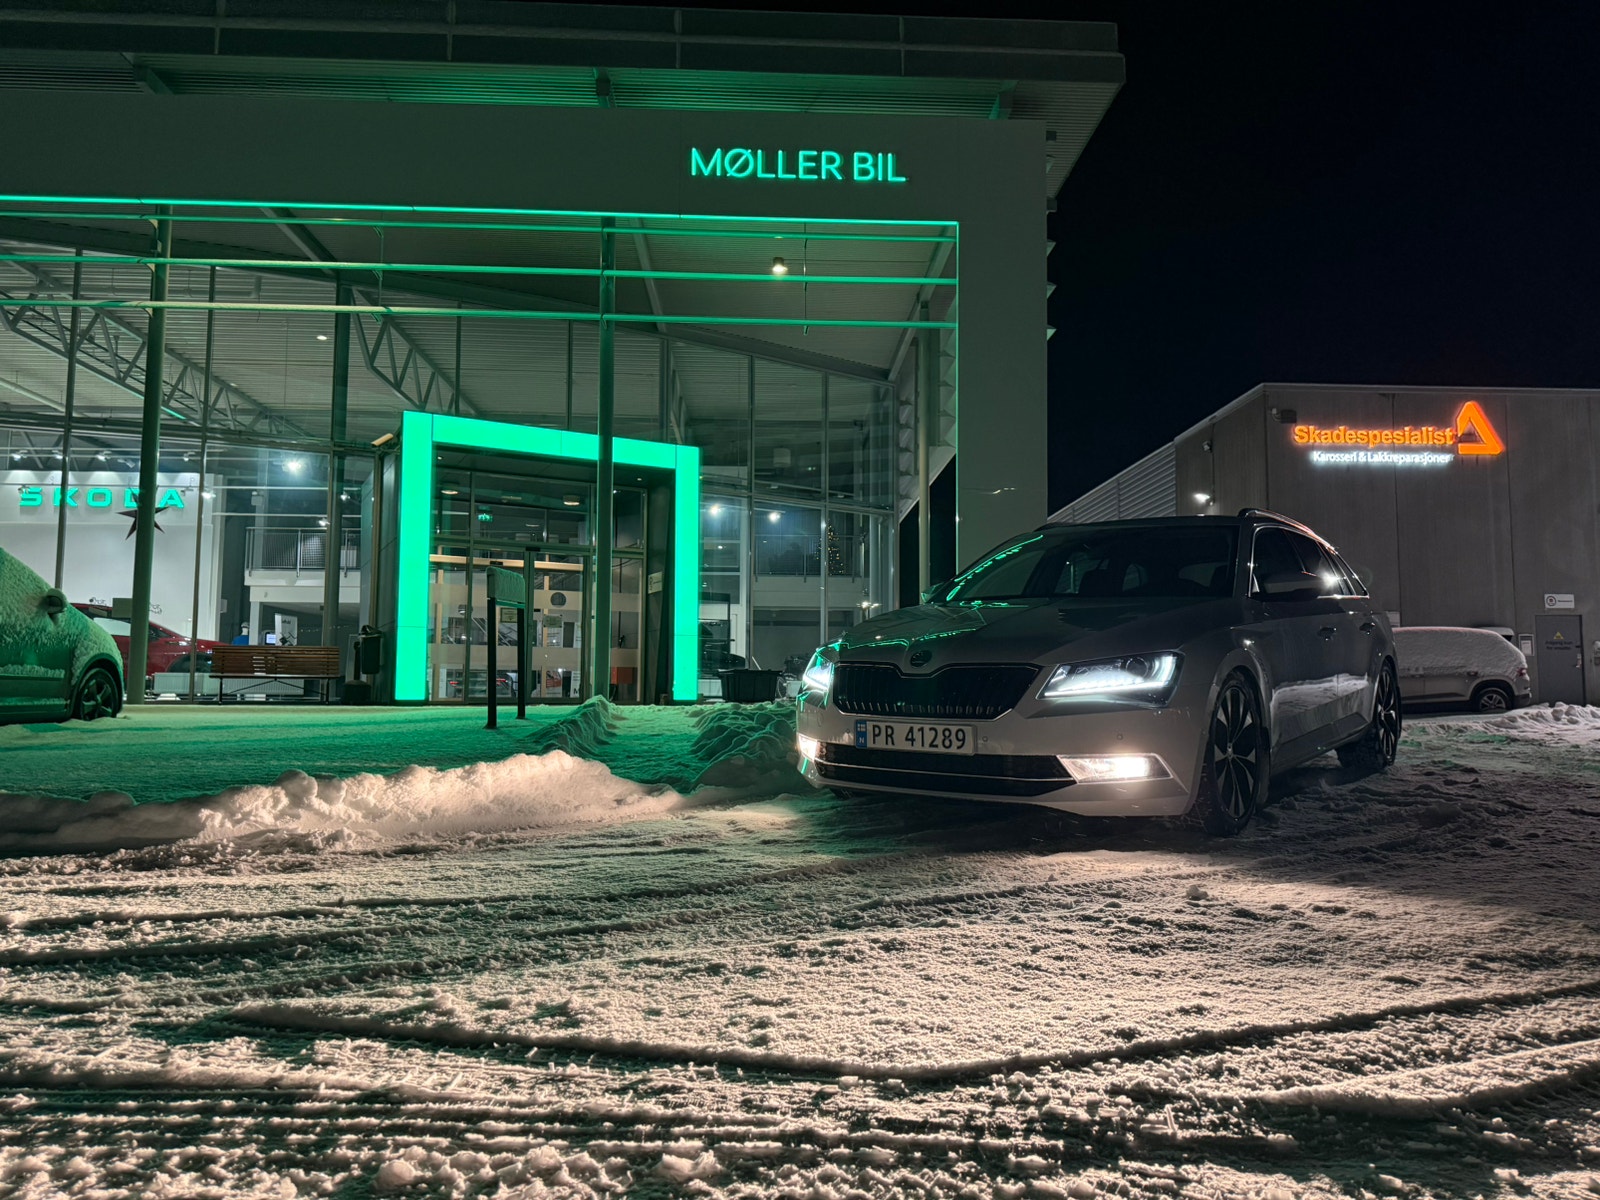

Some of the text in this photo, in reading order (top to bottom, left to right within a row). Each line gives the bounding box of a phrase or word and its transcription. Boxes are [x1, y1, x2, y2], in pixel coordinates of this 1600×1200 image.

[690, 147, 908, 183] MØLLER BIL
[1293, 424, 1454, 449] Skadespesialist
[1313, 451, 1357, 463] Karosseri
[1358, 452, 1367, 463] &
[872, 724, 967, 750] PR 41289
